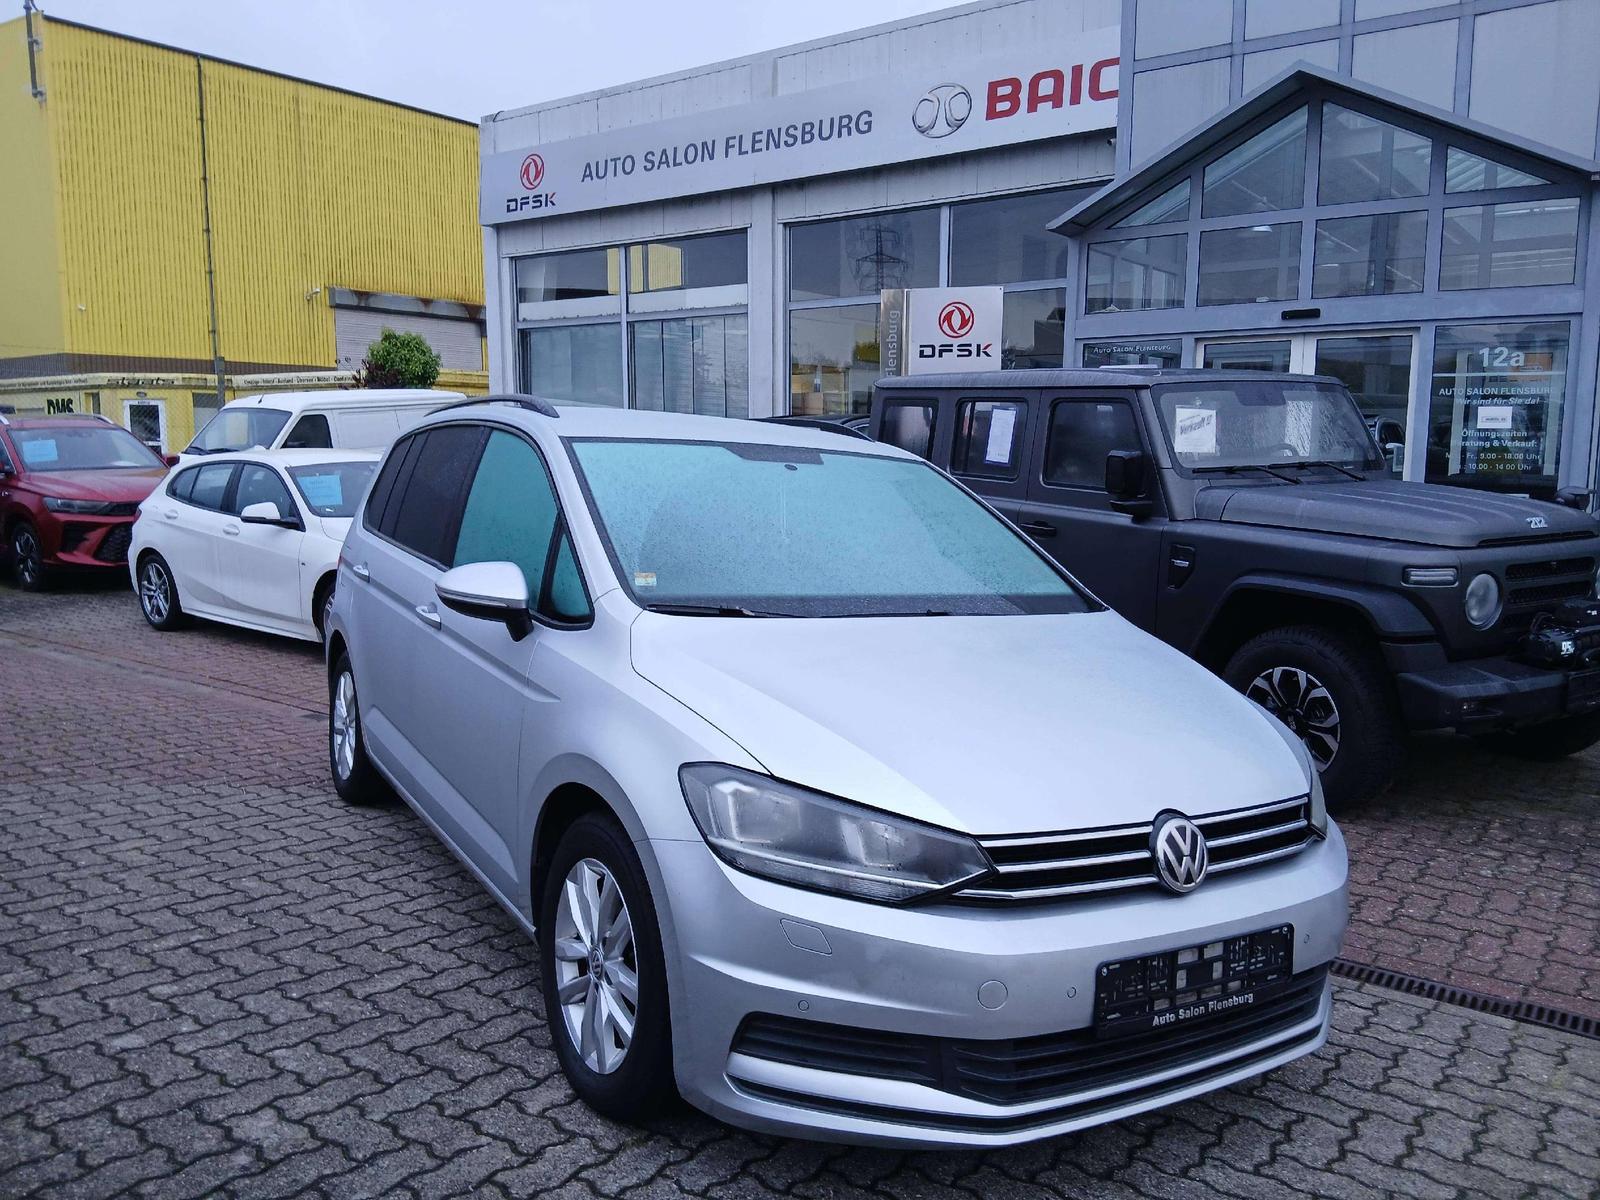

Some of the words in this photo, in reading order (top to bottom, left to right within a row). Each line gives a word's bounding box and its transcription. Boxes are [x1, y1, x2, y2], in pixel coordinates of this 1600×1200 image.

[985, 57, 1120, 121] BAIC
[581, 154, 635, 183] AUTO
[643, 139, 716, 172] SALON
[724, 110, 873, 159] FLENSBURG
[506, 192, 557, 214] DFSK
[919, 343, 993, 358] DFSK
[1479, 346, 1526, 367] 12a
[1438, 388, 1464, 396] AUTO
[1466, 387, 1498, 395] SALON
[1152, 1013, 1177, 1027] Auto
[1178, 1005, 1205, 1020] Salon
[1208, 993, 1254, 1011] Flensburg
